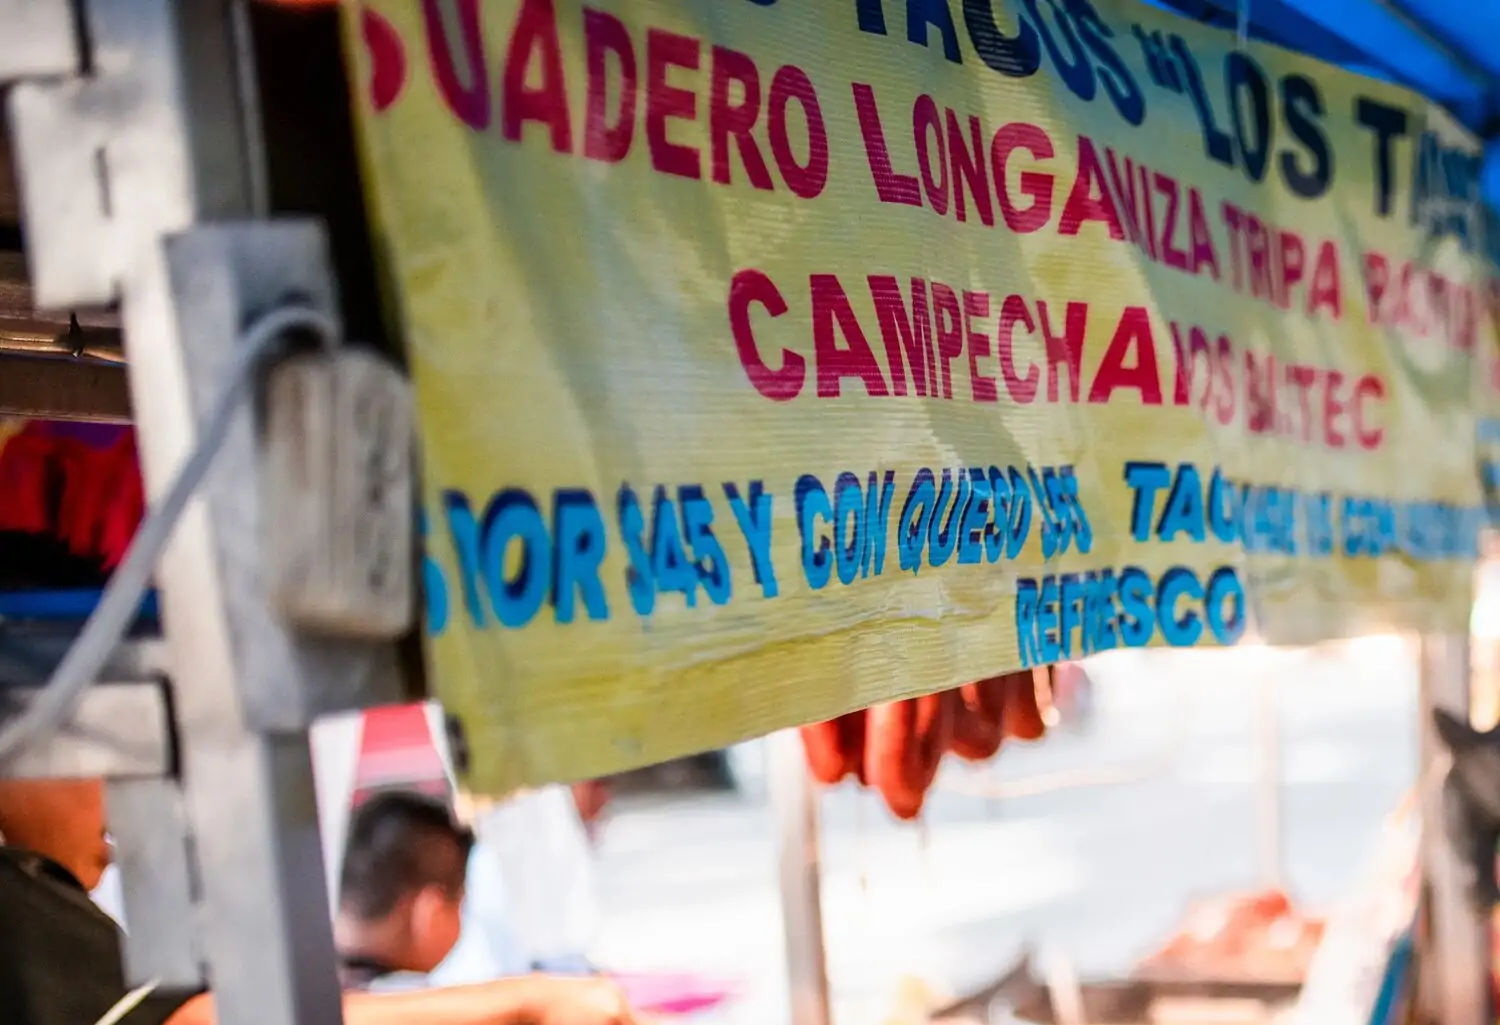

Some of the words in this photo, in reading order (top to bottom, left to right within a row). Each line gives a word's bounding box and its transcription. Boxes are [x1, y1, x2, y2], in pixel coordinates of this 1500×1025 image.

[857, 0, 1145, 126] ACOS
[853, 83, 1220, 281] LONGANIZA
[1221, 201, 1342, 320] TRIPA
[721, 480, 778, 598] Y
[793, 469, 896, 590] CON
[897, 464, 1032, 576] QUESO
[1015, 565, 1248, 668] REFRESCO
